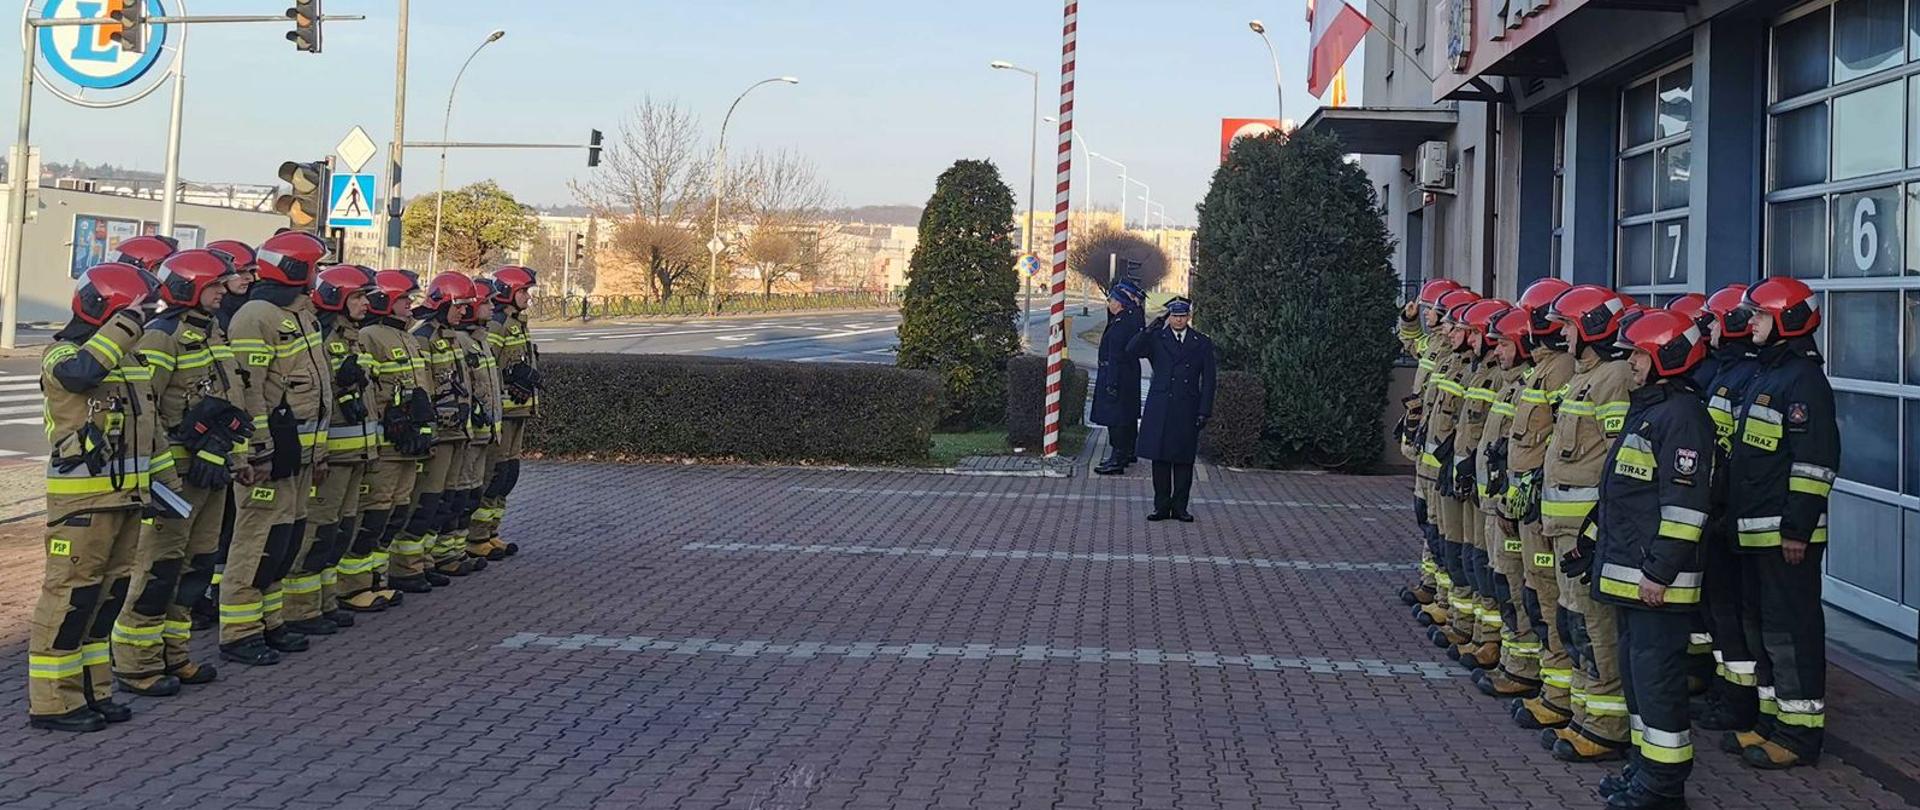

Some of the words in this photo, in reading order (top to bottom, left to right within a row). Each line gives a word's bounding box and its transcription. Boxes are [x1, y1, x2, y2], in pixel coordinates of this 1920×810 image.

[1853, 196, 1878, 271] 6
[1667, 224, 1682, 279] 7
[251, 355, 267, 364] PSP
[1606, 418, 1621, 430] PSP
[254, 489, 272, 499] PSP
[53, 541, 67, 552] PSP
[1507, 542, 1522, 550] PSP
[1536, 555, 1551, 565] PSP
